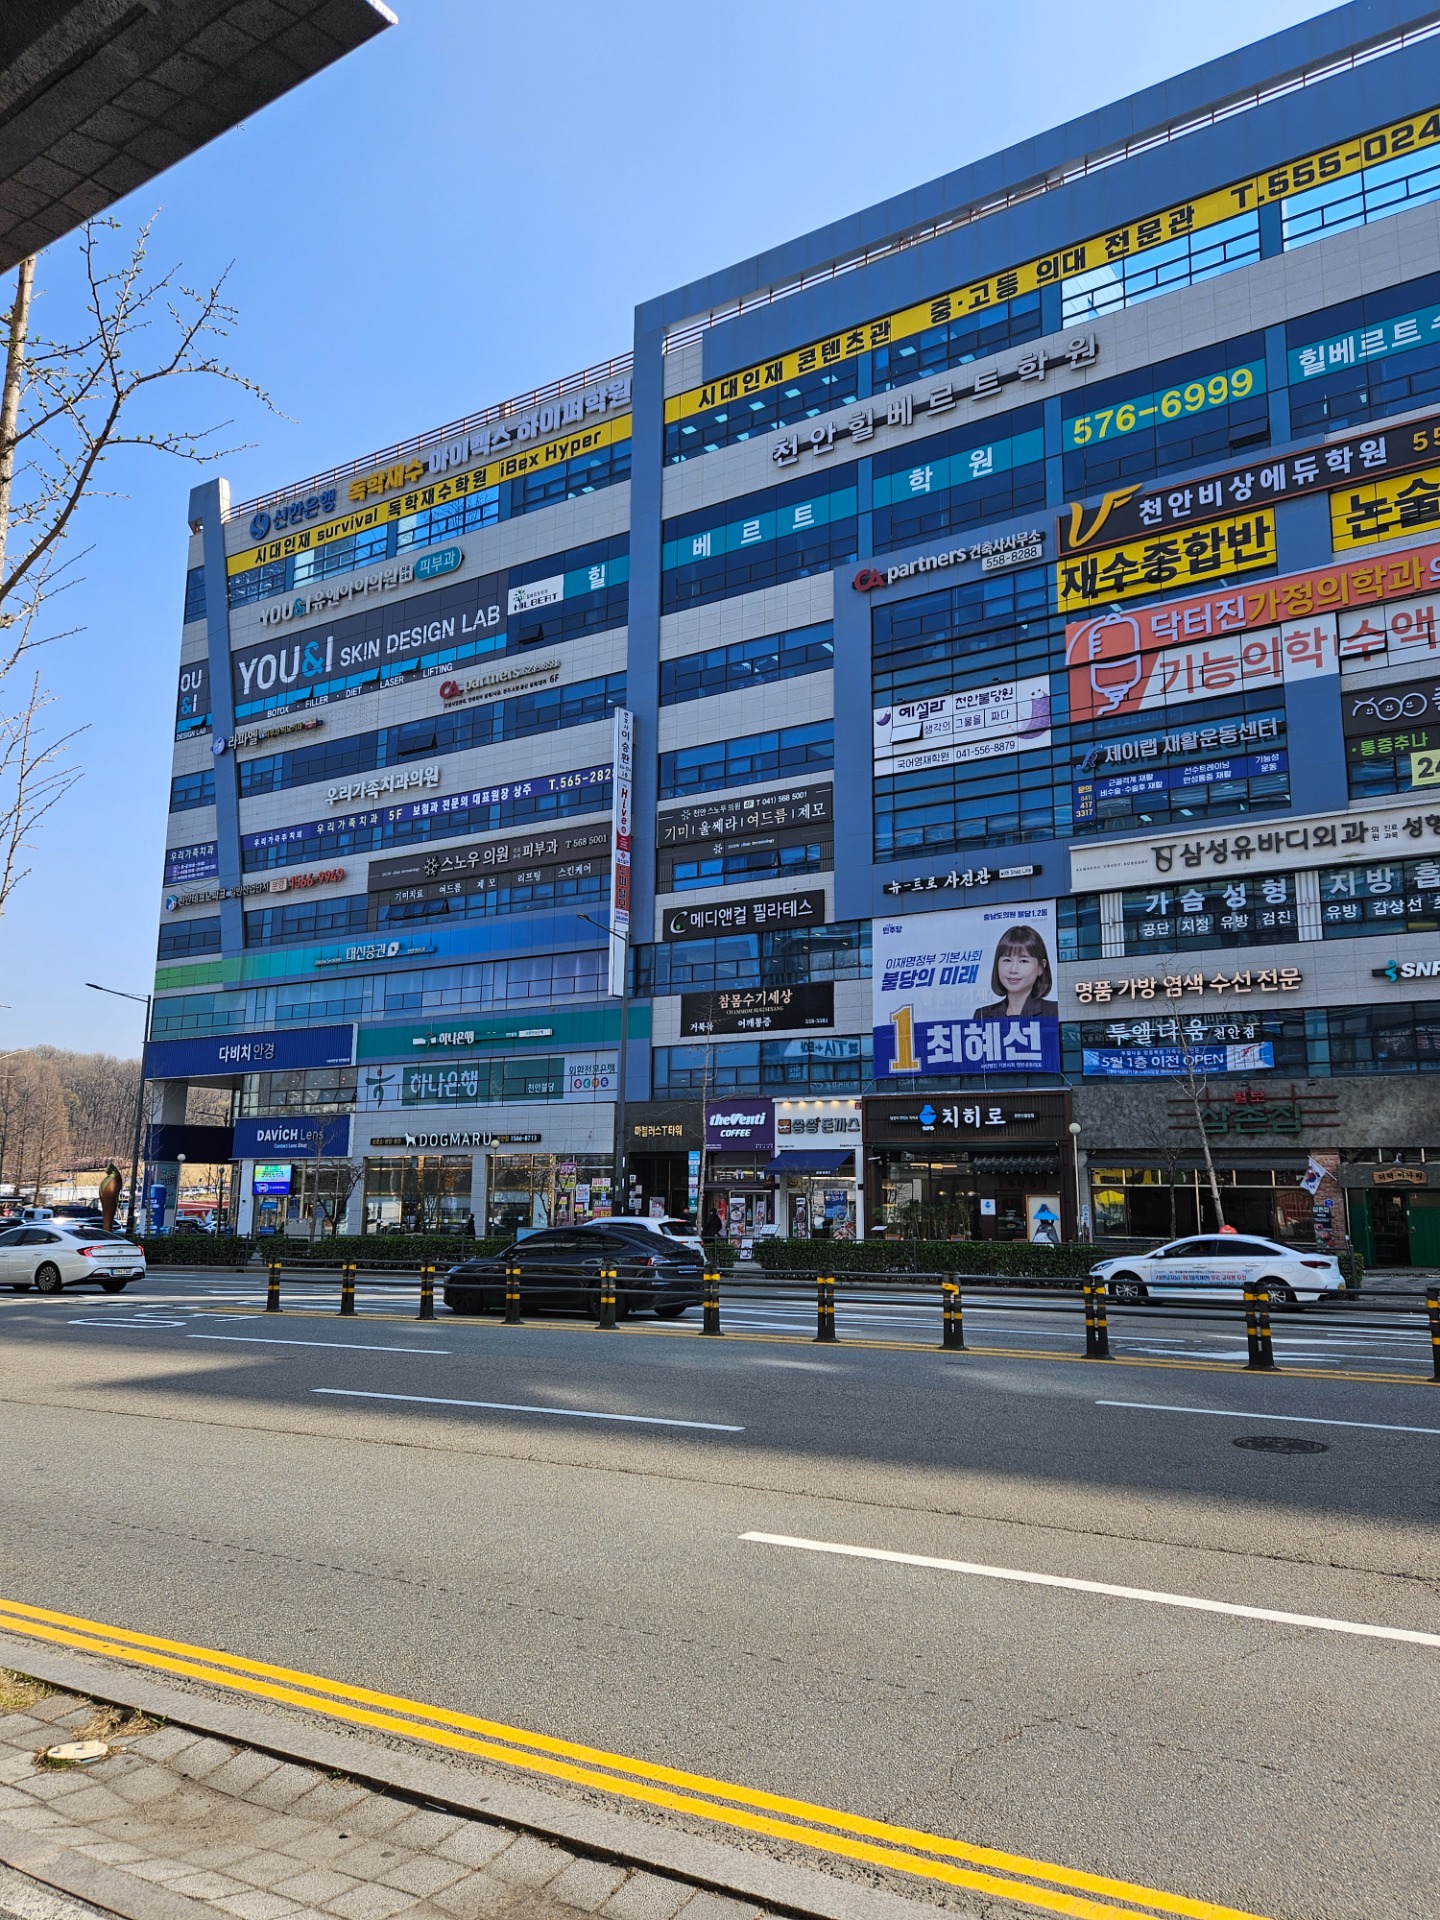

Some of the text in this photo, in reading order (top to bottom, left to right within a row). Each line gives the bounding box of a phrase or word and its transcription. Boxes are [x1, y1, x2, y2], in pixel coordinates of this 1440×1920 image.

[698, 361, 783, 408] 시대인재
[797, 321, 890, 372] 콘텐츠관
[1036, 246, 1086, 284] 의대
[1104, 203, 1194, 259] 전문관
[1298, 318, 1422, 377] 힐베르트
[1073, 368, 1253, 445] 576-6999
[348, 459, 425, 501] 독학재수
[1138, 436, 1388, 526] 천안비상에듀학원
[255, 431, 601, 564] 시대인재 survival 독학재수학원 iBex Hyper
[273, 488, 336, 530] 신한은행
[419, 550, 456, 574] 피부과
[887, 547, 967, 585] partners
[969, 528, 1043, 558] 건축사사무소
[986, 546, 1038, 568] 558-8288
[1060, 515, 1271, 599] 재수종합반
[588, 564, 606, 590] 힐
[513, 592, 559, 611] HILBERT
[239, 605, 500, 695] YOU&I SKIN DESIGN LAB
[1158, 605, 1437, 695] 기능의학 수액
[180, 669, 202, 692] OU
[267, 663, 453, 718] BOTOX FILLER DIET LASER LIFTING
[462, 666, 521, 692] partners
[176, 727, 207, 741] DESIGN LAB
[924, 709, 1009, 735] 생각의 그물을 짜다
[228, 728, 258, 749] 라파엘
[1104, 717, 1278, 763] 제이랩 재활운동센터
[1360, 732, 1428, 757] 통증추나
[897, 740, 1015, 769] 국어영재학원 041-556-8879
[1255, 753, 1280, 764] 기능성
[1260, 763, 1278, 772] 운동
[325, 765, 439, 806] 우리가족치과의원
[1138, 773, 1154, 782] 재활
[1147, 781, 1163, 790] 재활
[1215, 770, 1232, 780] 재활
[316, 813, 378, 834] 우리가족치과
[388, 808, 403, 822] 5F
[412, 801, 439, 817] 보철과
[441, 796, 468, 811] 전문의
[472, 787, 510, 806] 대표원장
[512, 782, 532, 798] 상주
[548, 768, 614, 791] T.565-282
[693, 807, 706, 817] 천안
[707, 804, 727, 815] 스노우
[728, 802, 741, 811] 의원
[791, 791, 808, 800] 5001
[1076, 809, 1094, 818] 3317
[1079, 801, 1093, 809] 417
[664, 802, 827, 841] 기미 울쎄라 여드름 제모
[170, 845, 214, 861] 우리가족치과
[440, 851, 480, 872] 스노우
[482, 845, 510, 865] 의원
[522, 839, 559, 859] 피부과
[573, 837, 587, 848] 568
[588, 834, 608, 845] 5001
[1180, 821, 1370, 869] 삼성유바디외과
[289, 867, 345, 890] 1566-9949
[438, 883, 462, 894] 여드름
[476, 877, 497, 890] 제모
[517, 871, 541, 883] 리프팅
[557, 863, 592, 877] 스킨케어
[944, 867, 991, 888] 사진관
[1145, 878, 1289, 915] 가슴성형
[690, 899, 814, 929] 메디앤컬 필라테스
[1143, 922, 1170, 937] 공단
[1181, 918, 1209, 933] 지정
[1220, 914, 1249, 929] 유방
[1262, 910, 1291, 927] 검진
[1326, 903, 1358, 920] 유방
[1373, 899, 1423, 916] 갑상선
[345, 944, 386, 961] 대신증권
[886, 949, 983, 969] 이재명정부 기본사회
[881, 965, 979, 991] 불당의 미래
[1075, 967, 1302, 1004] 명품 가방 염색 수선 전문
[718, 989, 793, 1010] 참몸수기세상
[737, 1017, 772, 1029] 어깨통증
[1213, 1025, 1256, 1040] 천안점
[438, 1031, 475, 1045] 하나은행
[889, 1003, 922, 1073] 1
[927, 1021, 1042, 1064] 최혜선
[1102, 1053, 1224, 1069] 5월 1층 이전 OPEN
[410, 1070, 479, 1099] 하나은행
[527, 1083, 555, 1094] 천안불당
[1233, 1091, 1265, 1104] 털보
[709, 1112, 767, 1126] theVenti
[942, 1105, 1007, 1129] 치히로
[1201, 1104, 1302, 1134] 삼촌집
[300, 1128, 324, 1141] Lens
[419, 1131, 493, 1147] DOGMARU
[720, 1128, 752, 1138] COFFEE
